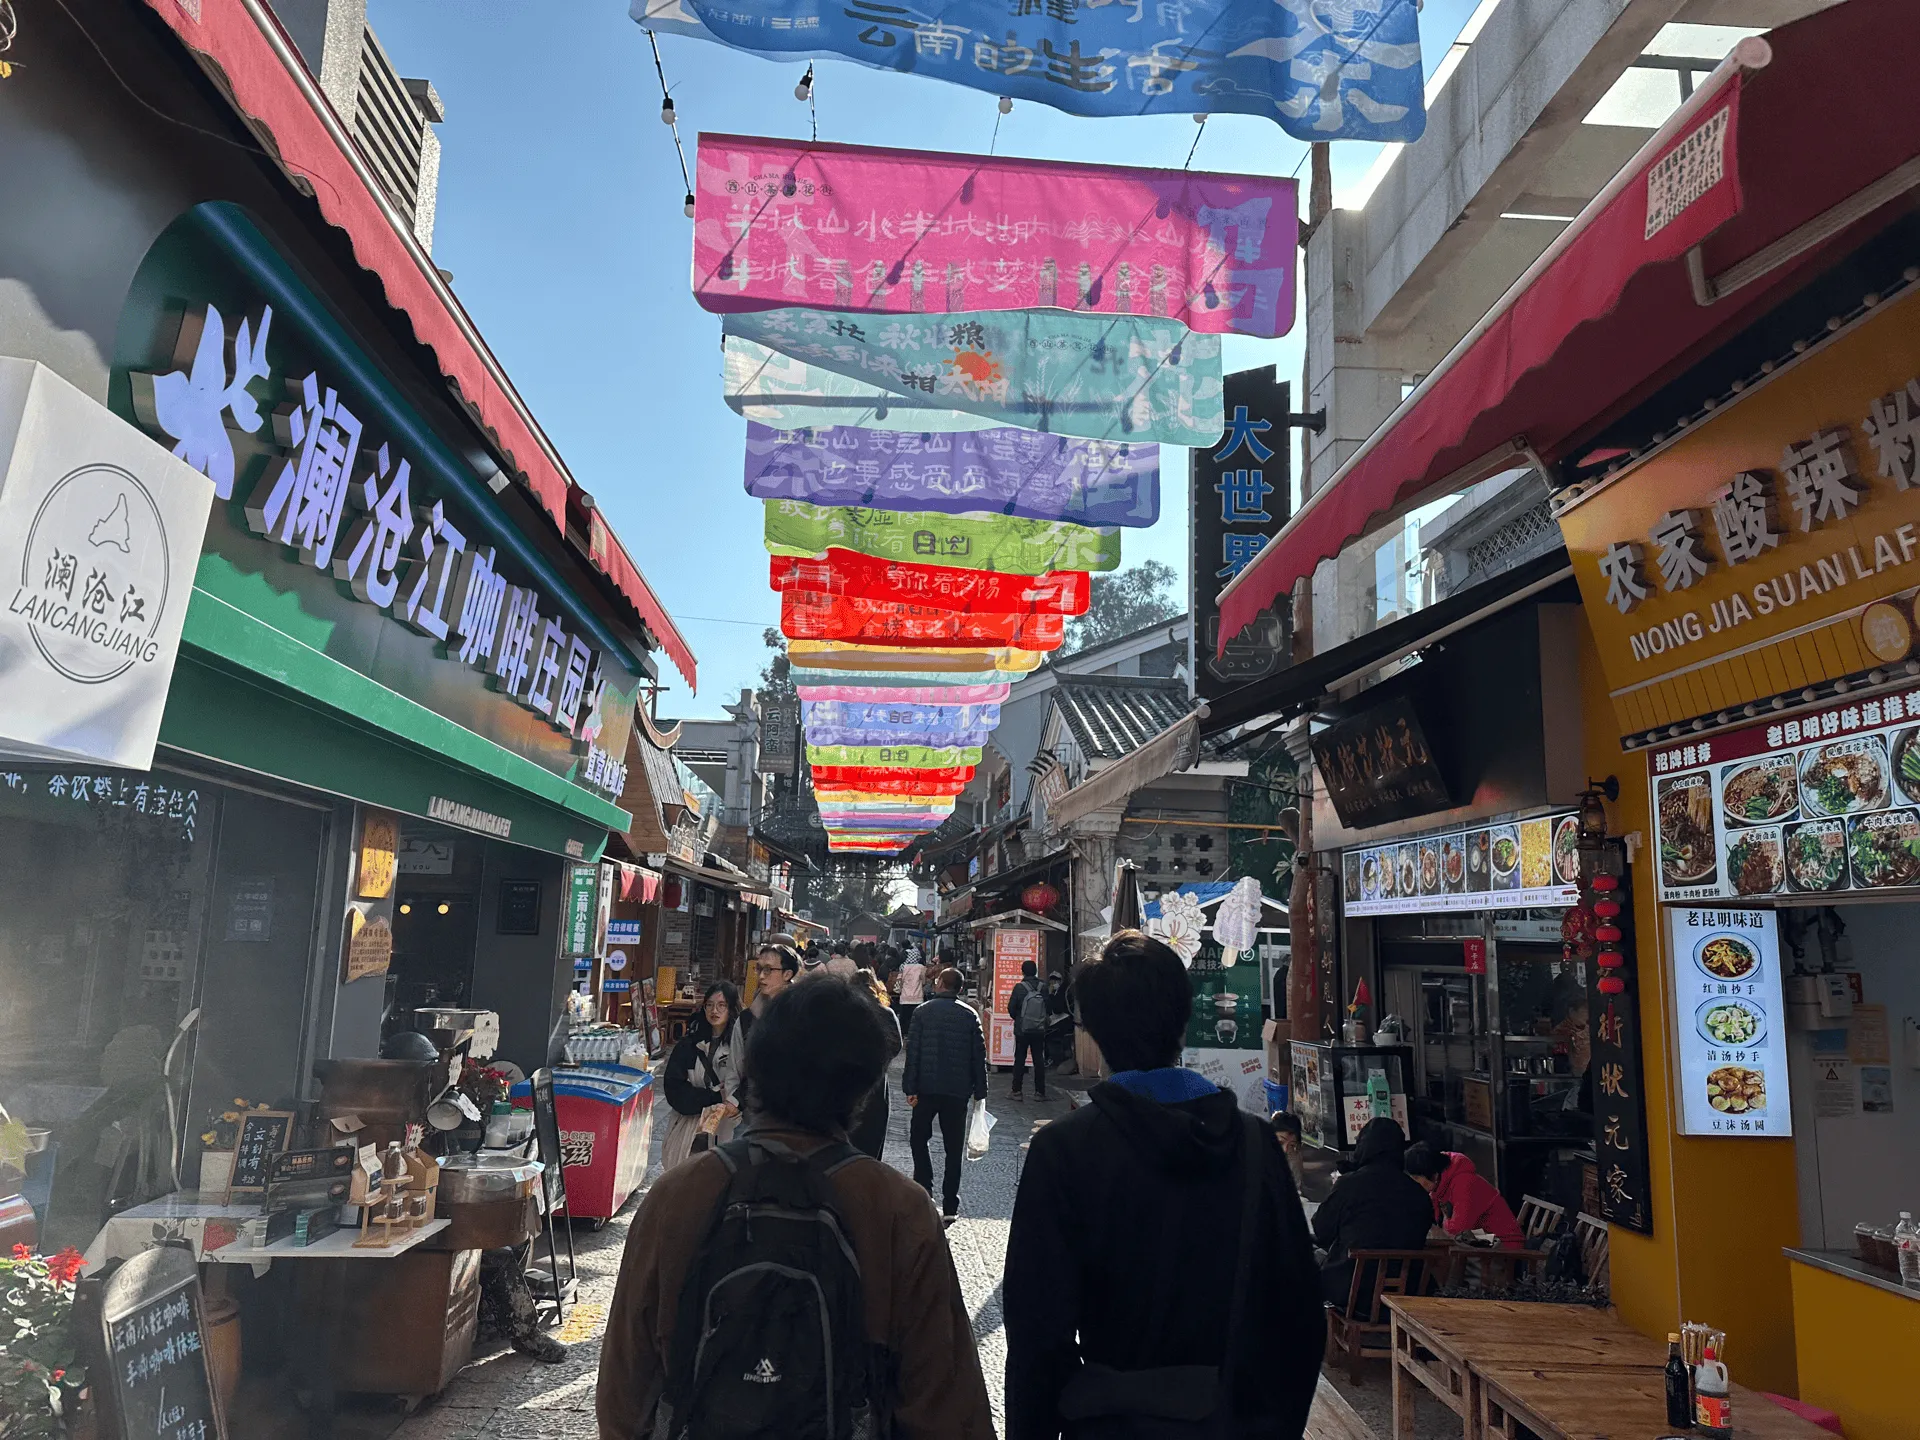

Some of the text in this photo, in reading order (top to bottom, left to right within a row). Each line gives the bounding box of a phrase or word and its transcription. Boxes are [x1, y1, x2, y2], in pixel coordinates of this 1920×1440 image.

[1213, 405, 1275, 588] 大世界
[44, 547, 145, 624] 澜沧江
[263, 371, 592, 737] 澜沧江咖啡庄园
[8, 588, 159, 662] LANCANGJIANG
[1629, 612, 1704, 662] NONG
[1707, 593, 1753, 634] JIA
[1752, 552, 1847, 616] SUAN
[1766, 690, 1920, 748] 老昆明好味道推荐
[1655, 742, 1712, 772] 招牌推荐
[572, 891, 590, 954] 云南小粒咖啡
[1686, 911, 1765, 929] 老昆明味道
[1702, 983, 1756, 995] 红油抄手
[1706, 1049, 1761, 1062] 清汤抄手
